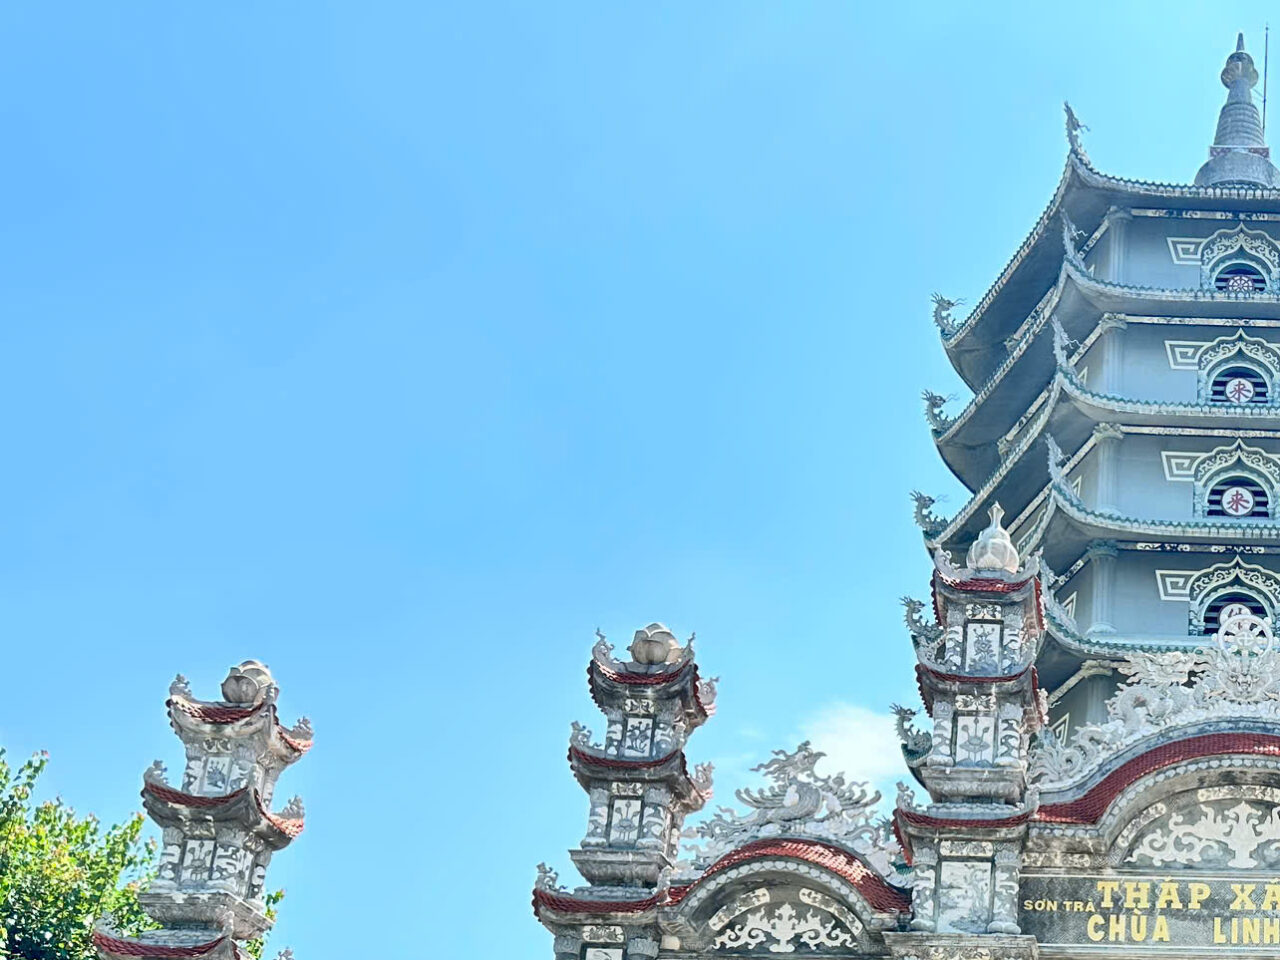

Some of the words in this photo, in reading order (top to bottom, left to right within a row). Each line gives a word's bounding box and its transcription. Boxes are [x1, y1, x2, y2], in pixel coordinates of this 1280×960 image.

[1023, 898, 1057, 911] SƠN
[1063, 898, 1095, 913] TRÀ
[1097, 876, 1211, 910] THÁP
[1087, 908, 1170, 942] CHÙA
[1214, 916, 1280, 944] LINH
